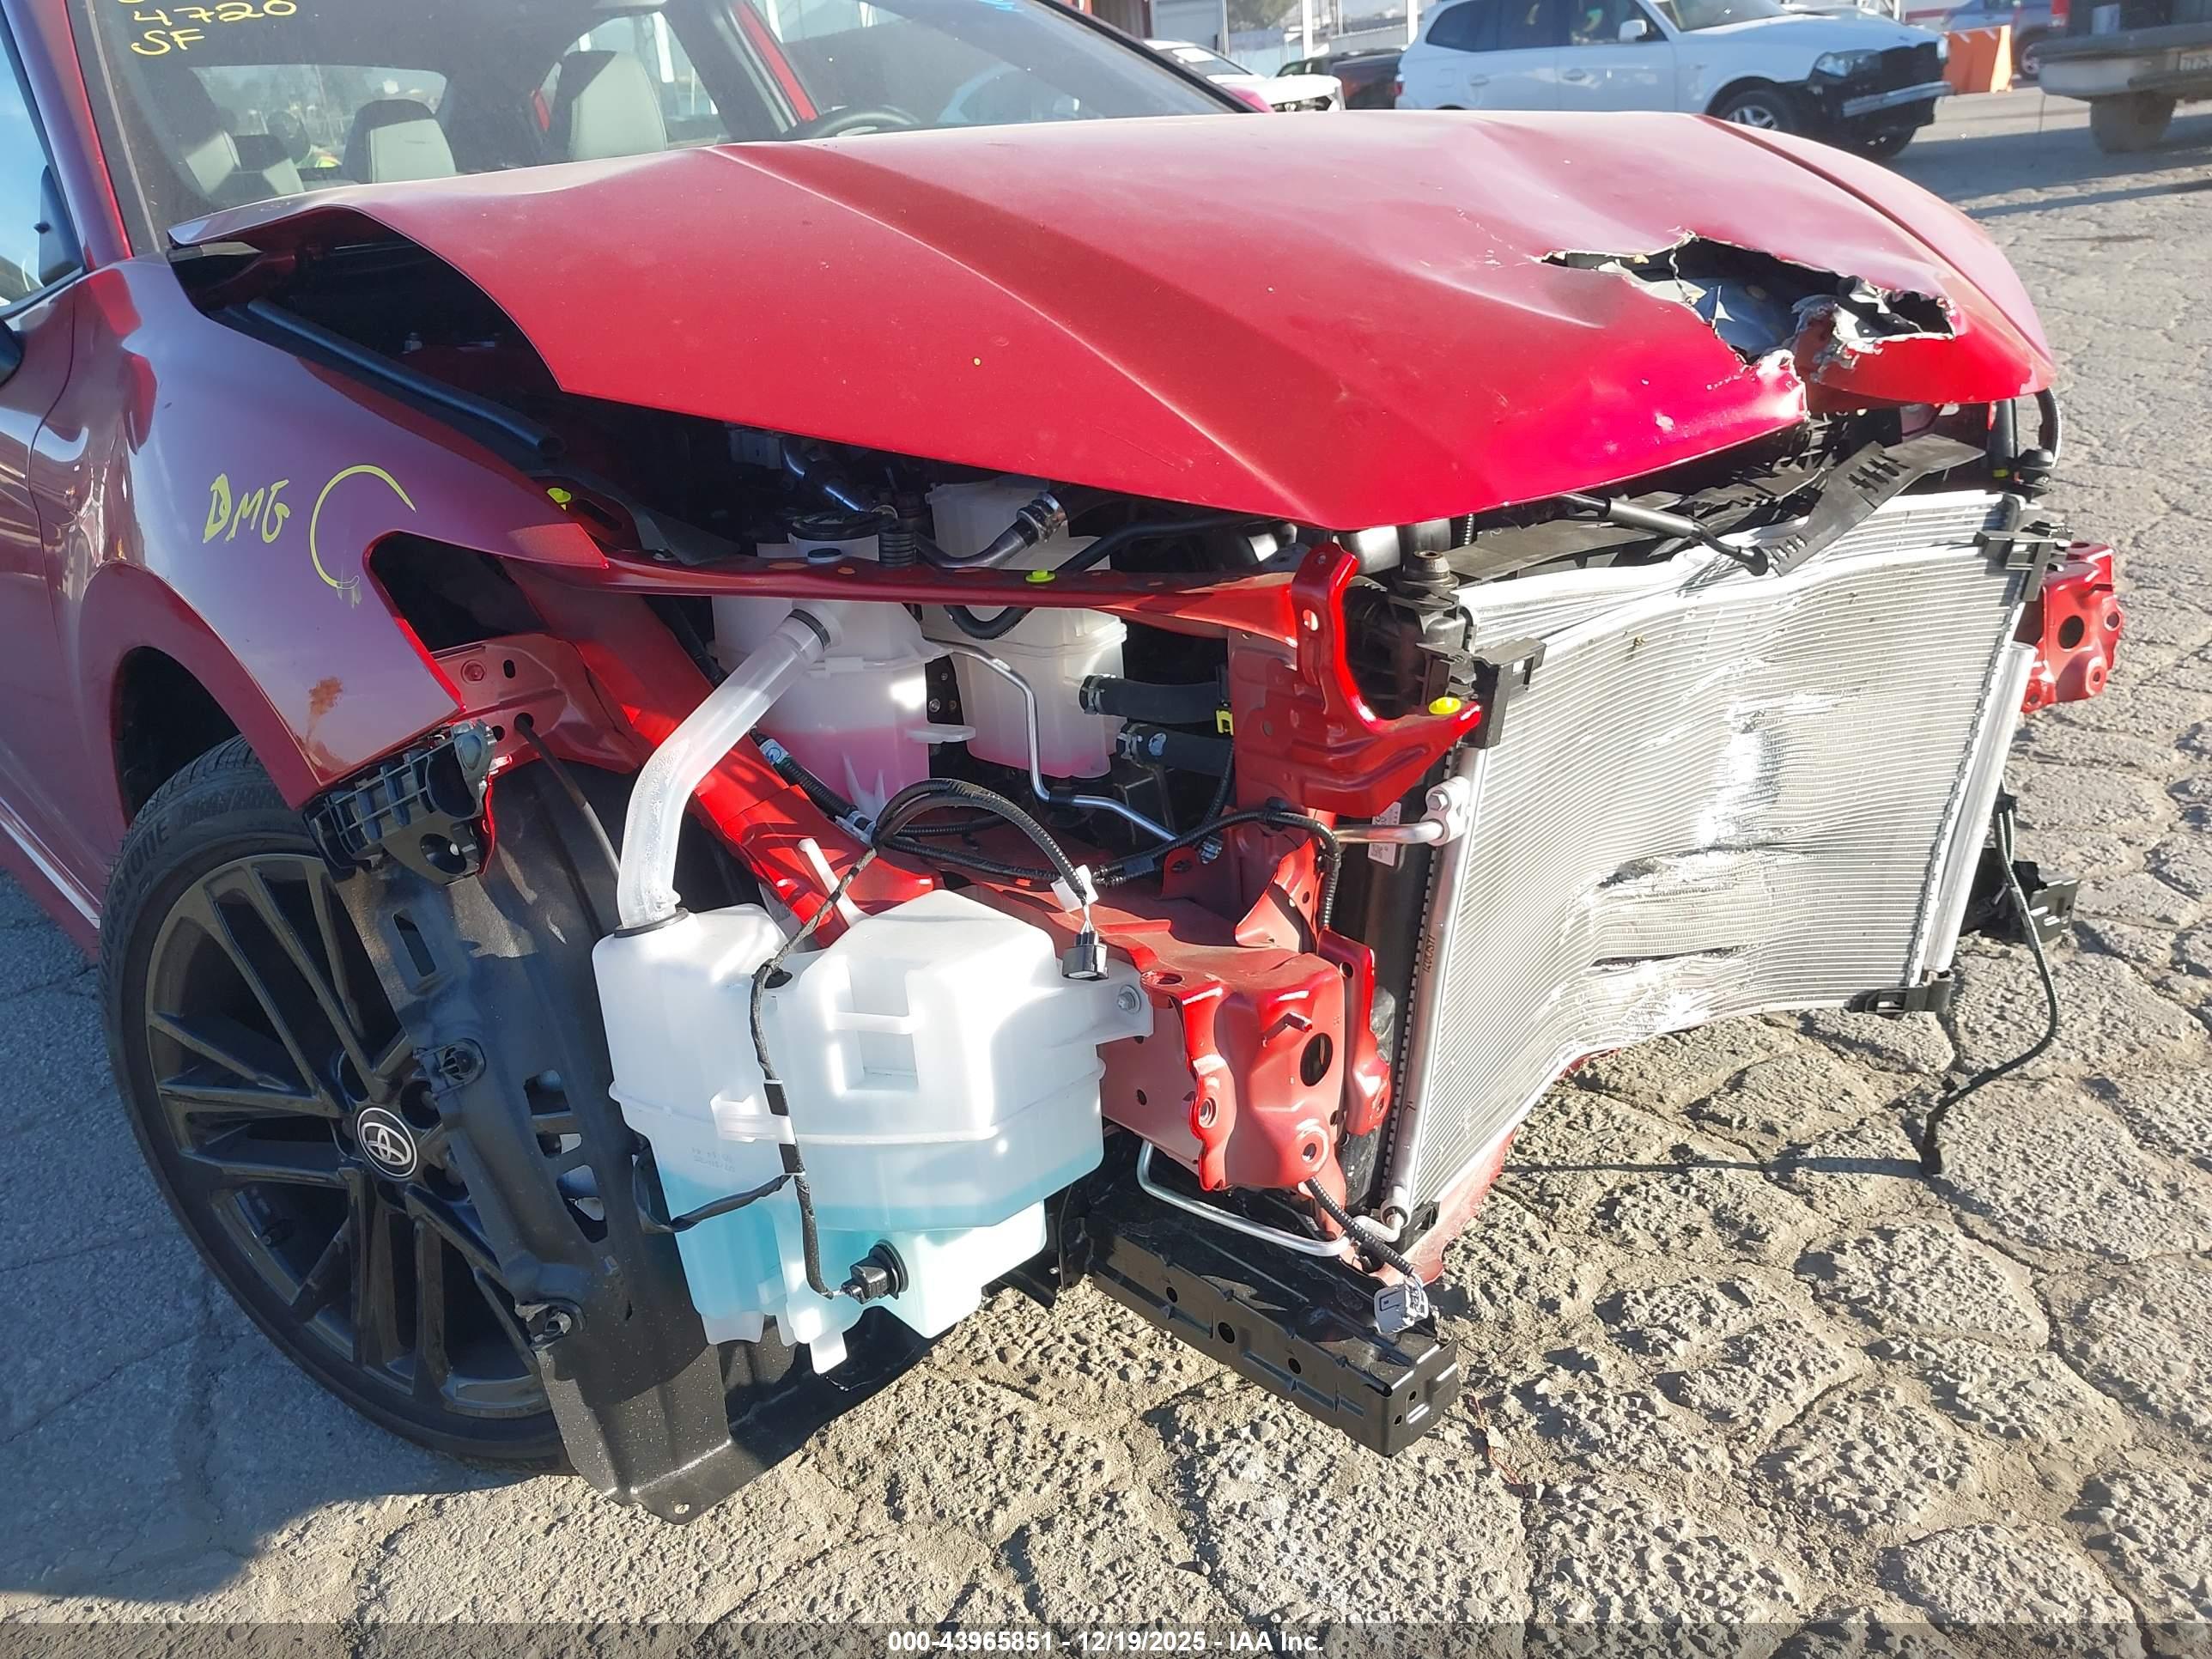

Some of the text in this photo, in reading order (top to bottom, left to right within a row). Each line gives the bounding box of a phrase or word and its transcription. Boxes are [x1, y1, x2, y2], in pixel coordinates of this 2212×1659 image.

[133, 0, 298, 27] 4720
[131, 28, 205, 56] SF
[203, 472, 291, 544] DMG
